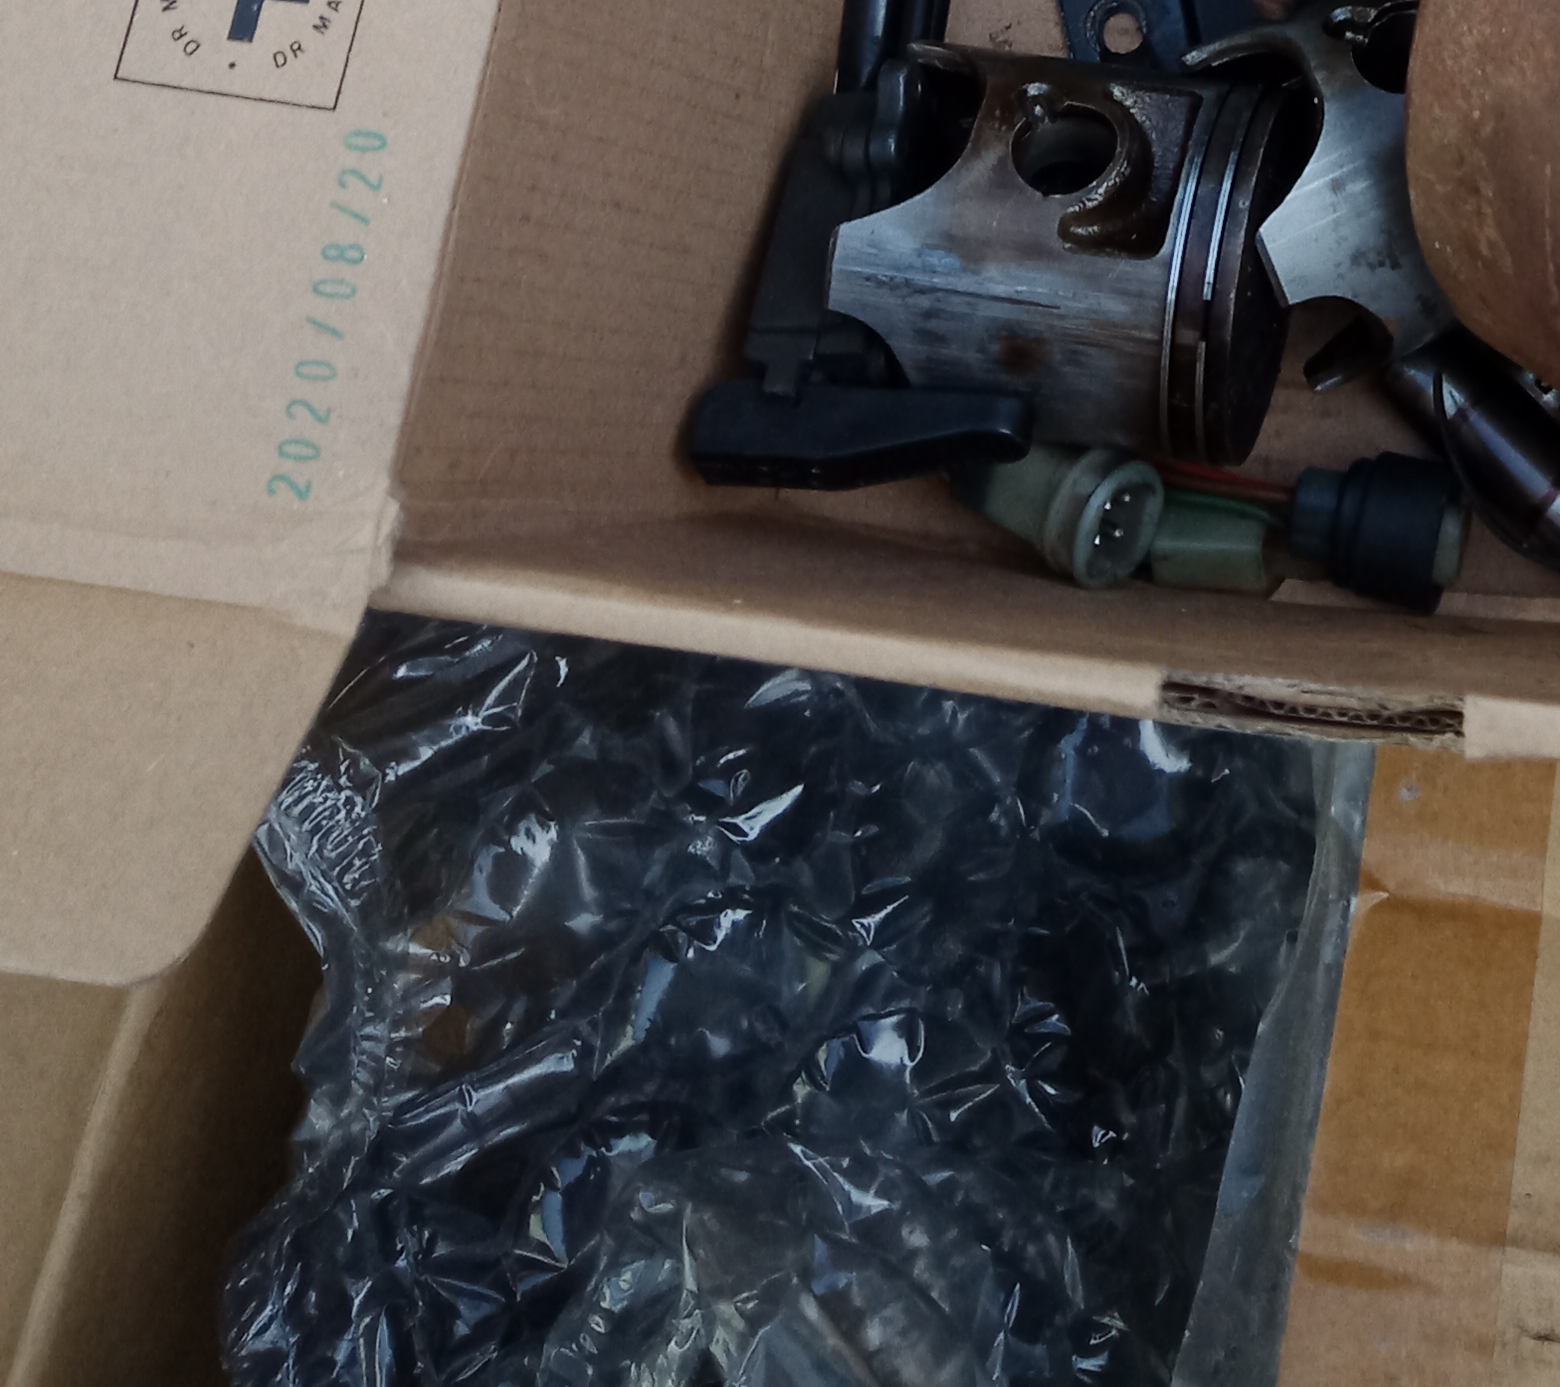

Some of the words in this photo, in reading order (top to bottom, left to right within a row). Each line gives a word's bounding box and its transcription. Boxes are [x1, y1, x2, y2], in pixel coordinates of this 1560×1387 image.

[170, 24, 201, 57] DR
[272, 39, 306, 70] DR
[266, 129, 388, 501] 2020/08/20
